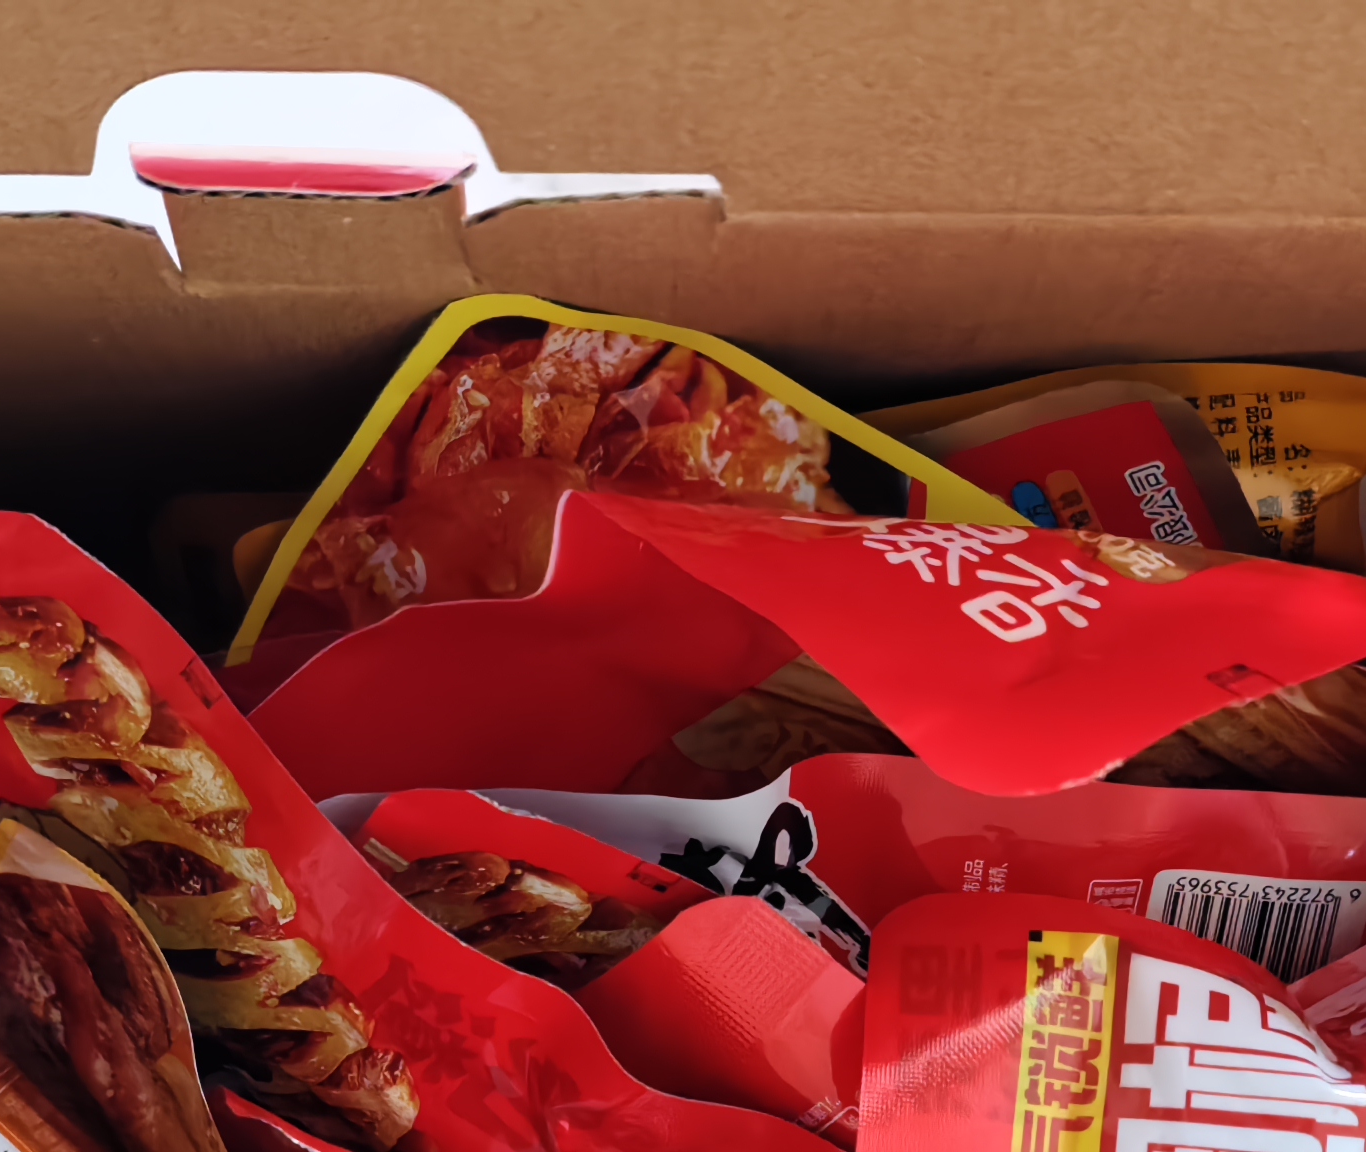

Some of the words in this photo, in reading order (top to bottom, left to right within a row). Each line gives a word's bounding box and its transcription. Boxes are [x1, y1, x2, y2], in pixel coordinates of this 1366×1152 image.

[1125, 460, 1204, 549] 限公司
[1175, 876, 1250, 899] 753965
[1262, 885, 1336, 904] 972243
[1349, 888, 1362, 904] 6
